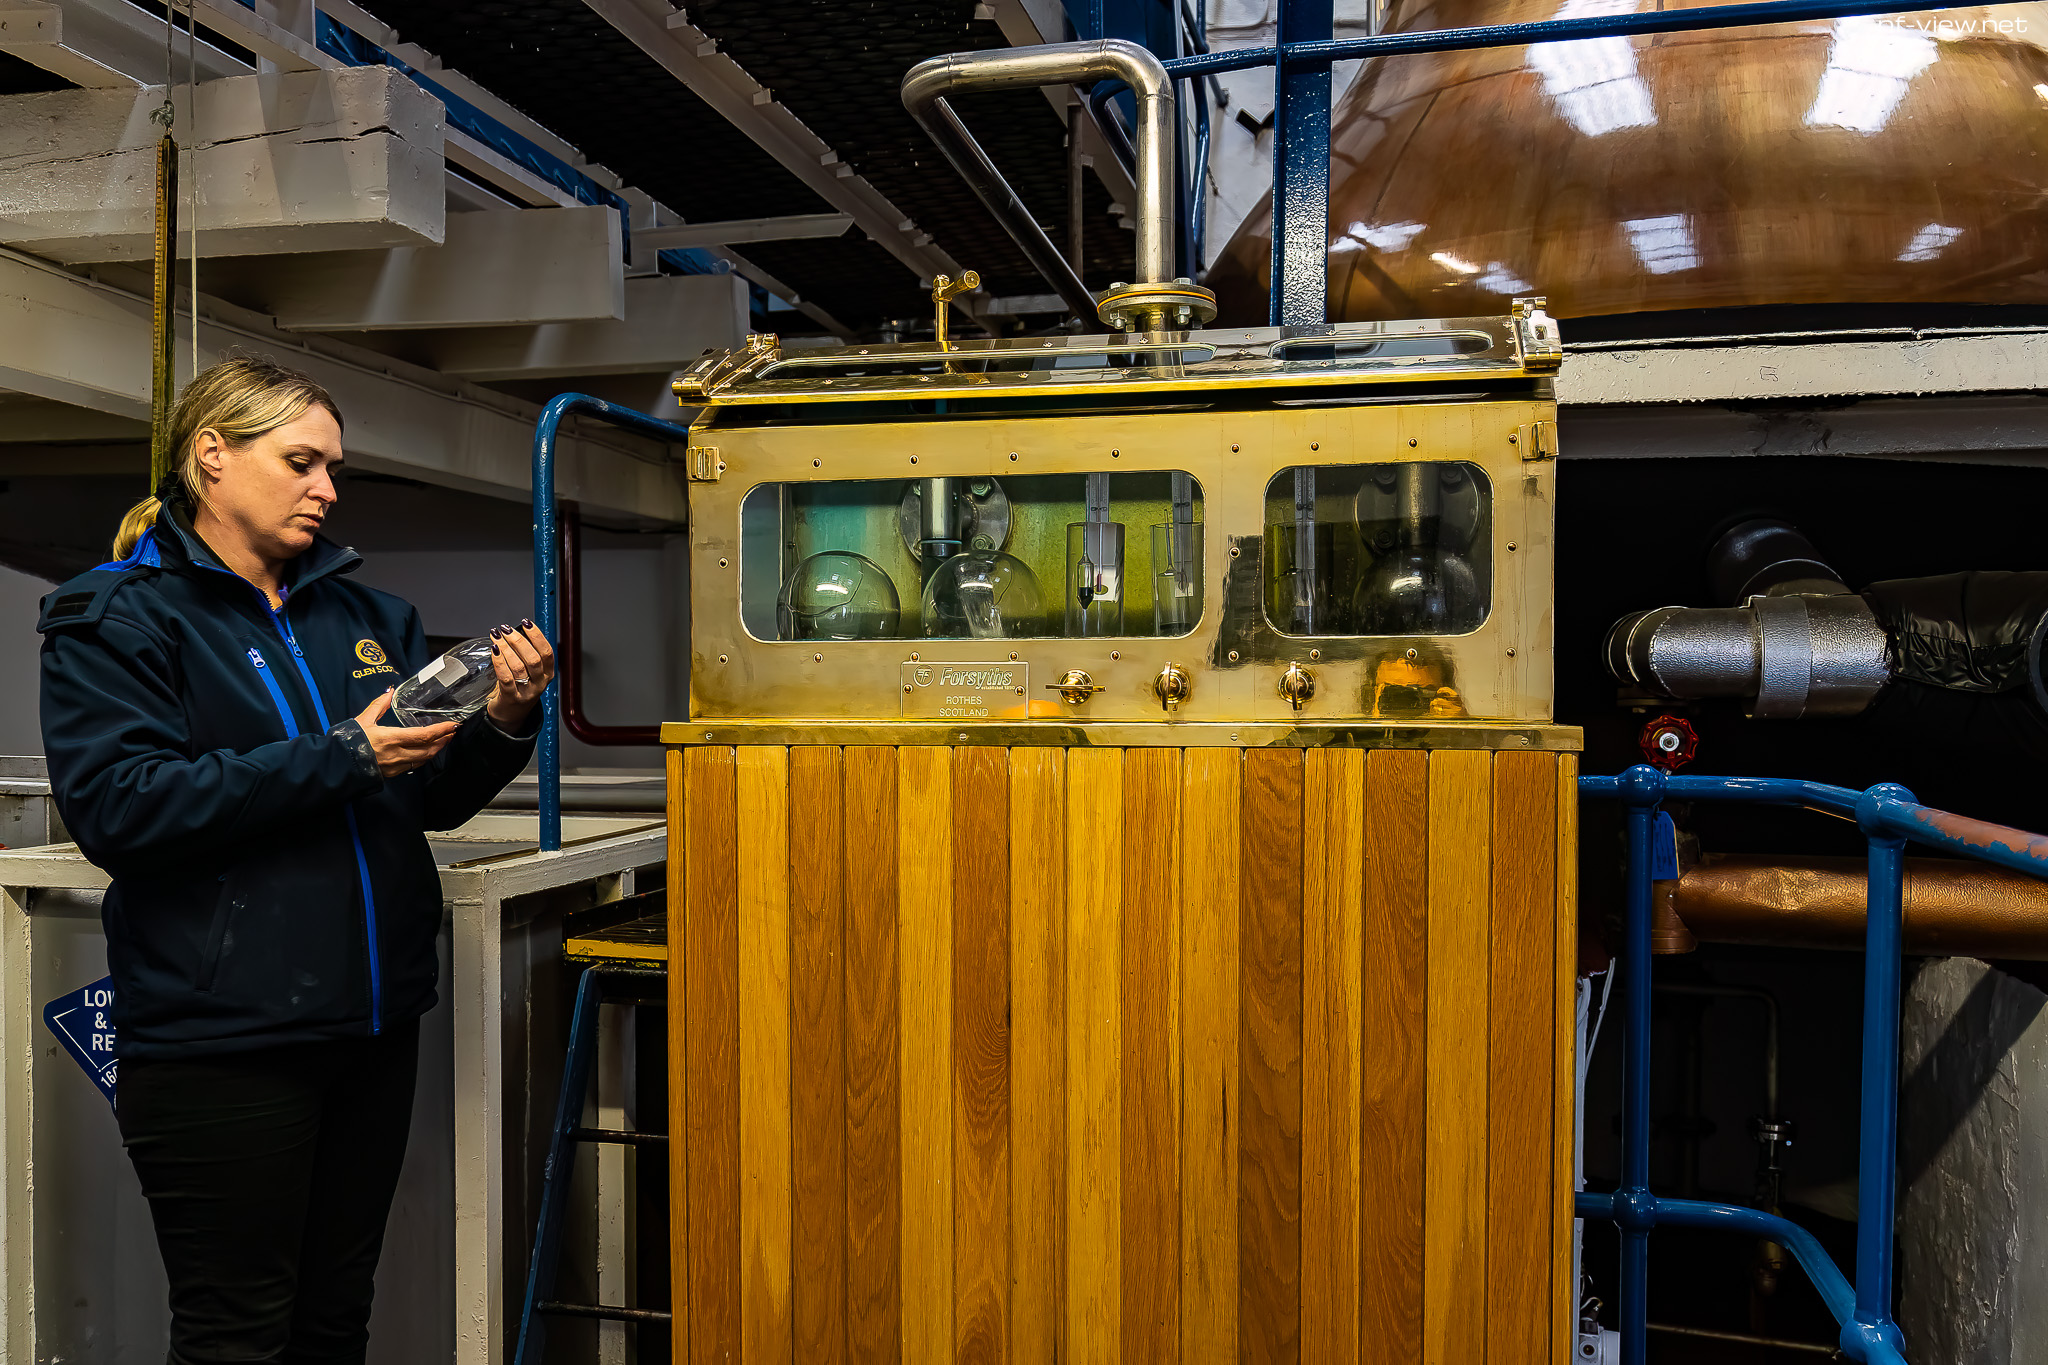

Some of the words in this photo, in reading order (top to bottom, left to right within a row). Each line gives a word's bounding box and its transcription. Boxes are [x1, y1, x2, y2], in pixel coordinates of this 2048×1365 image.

[352, 667, 377, 679] GLEN
[376, 665, 396, 674] SCO
[940, 667, 1012, 690] Forsyths
[946, 695, 982, 705] ROTHES
[939, 708, 989, 717] SCOTLAND
[94, 1011, 107, 1029] &
[92, 1033, 116, 1052] RE
